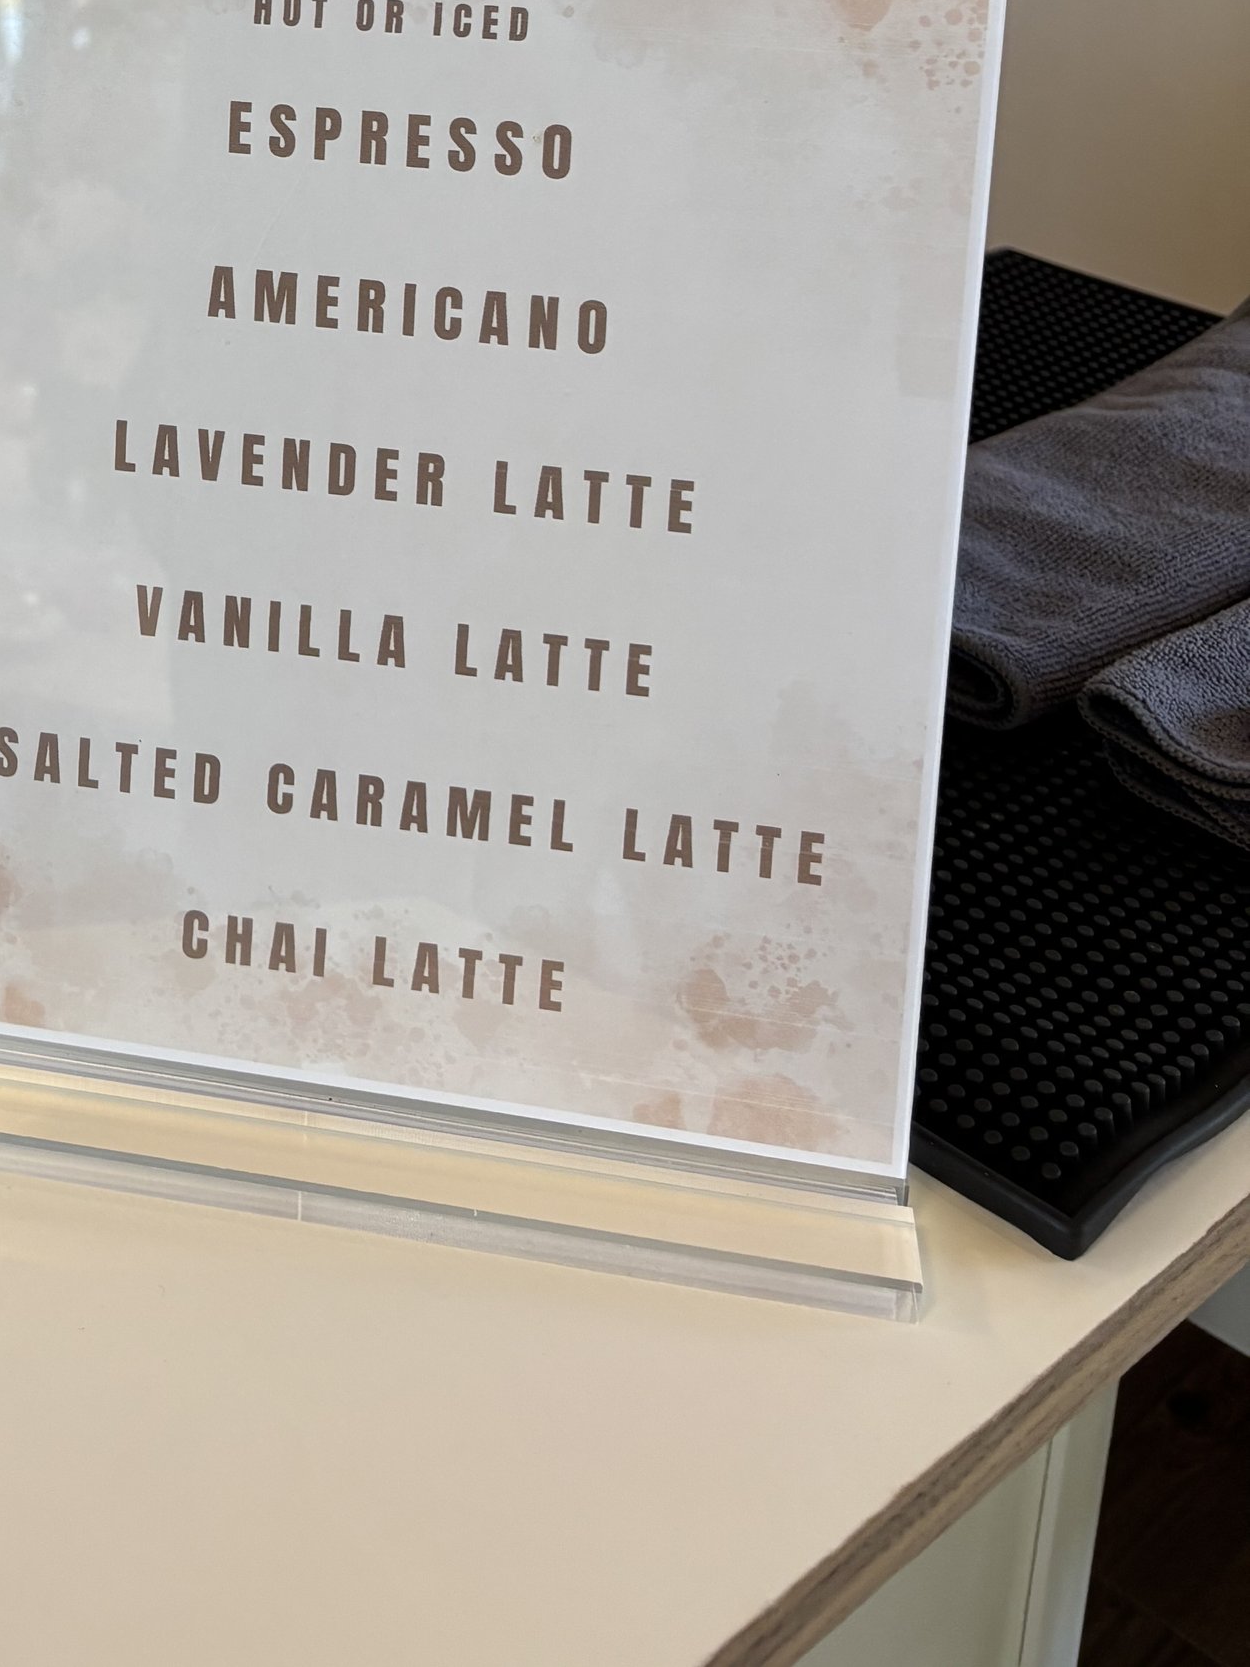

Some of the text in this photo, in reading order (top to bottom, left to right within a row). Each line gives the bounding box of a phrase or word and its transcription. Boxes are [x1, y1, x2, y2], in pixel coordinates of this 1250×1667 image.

[432, 1, 529, 42] ICED
[228, 100, 573, 180] ESPRESSO
[207, 265, 608, 355] AMERICANO
[114, 419, 696, 535] LAVENDER LATTE
[136, 584, 654, 698] VANILLA LATTE
[266, 763, 574, 853] CARAMEL
[622, 807, 826, 887] LATTE
[181, 909, 566, 1013] CHAI LATTE
